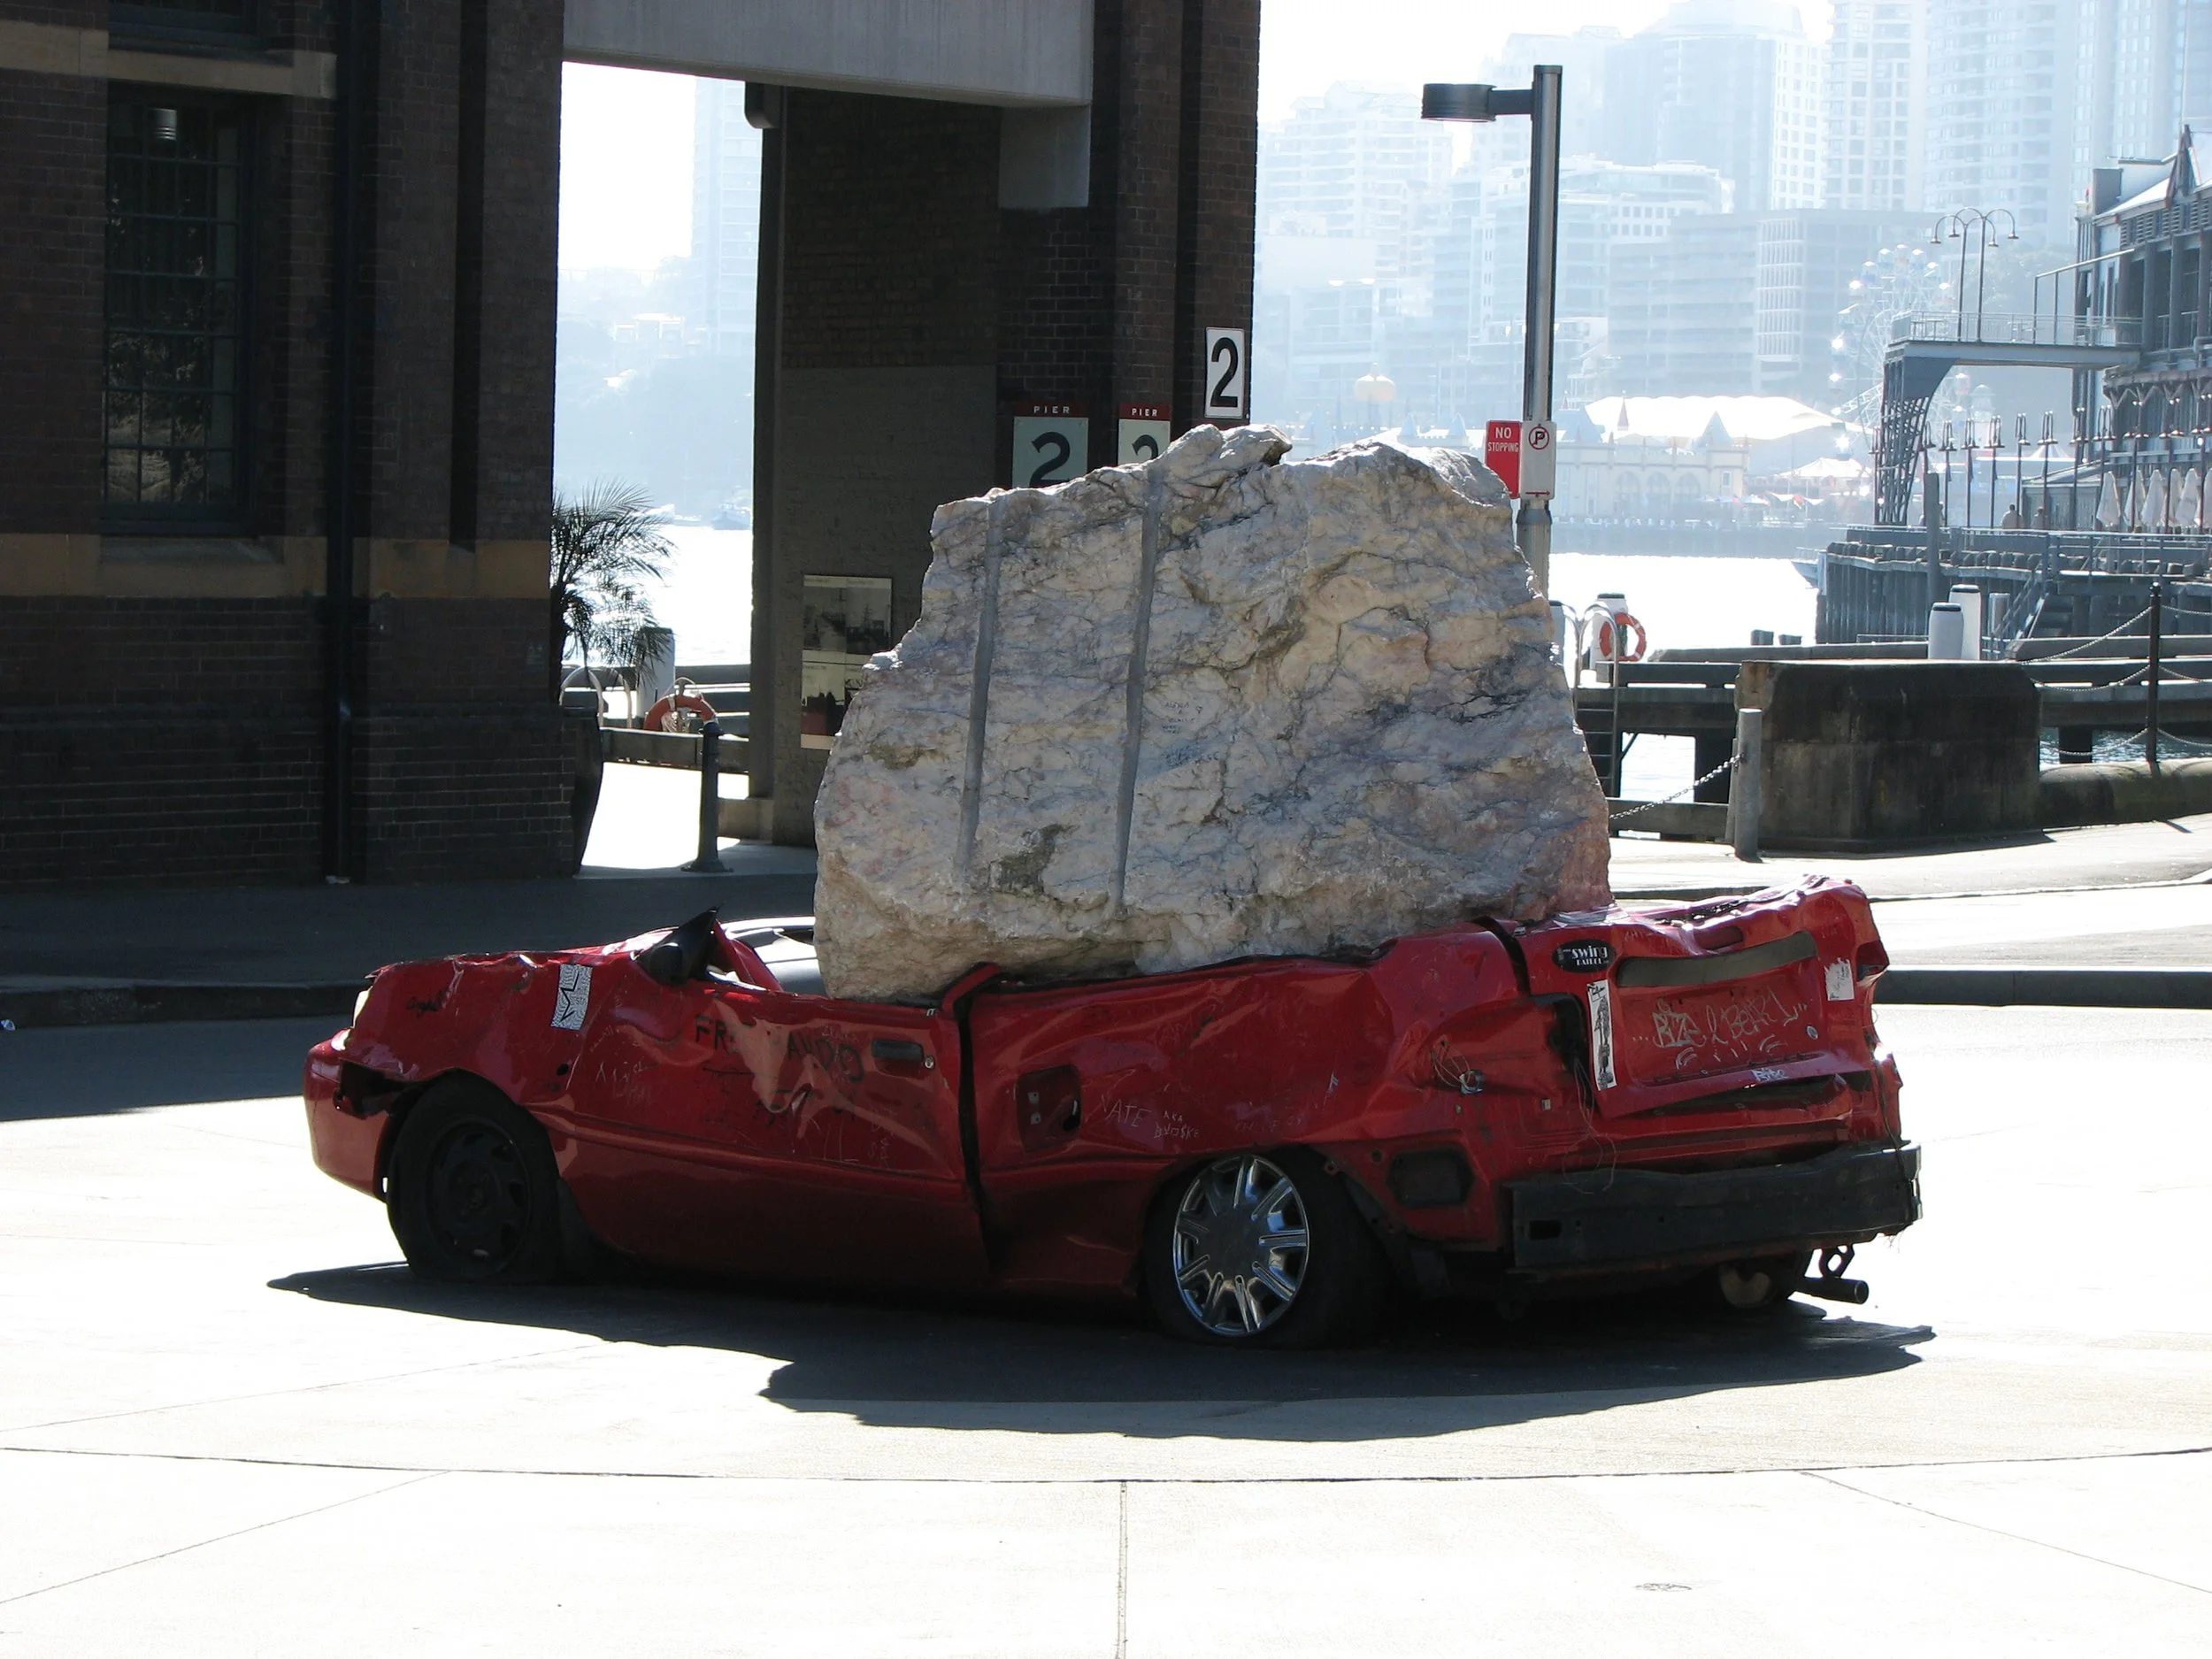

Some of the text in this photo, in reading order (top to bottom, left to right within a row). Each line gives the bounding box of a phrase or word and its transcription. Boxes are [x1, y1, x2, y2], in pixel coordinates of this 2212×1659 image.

[1210, 337, 1239, 407] 2
[1033, 405, 1071, 414] PIER
[1132, 407, 1158, 417] PIER
[1495, 426, 1512, 439] NO
[1487, 442, 1519, 452] STOPPING
[1030, 431, 1071, 487] 2
